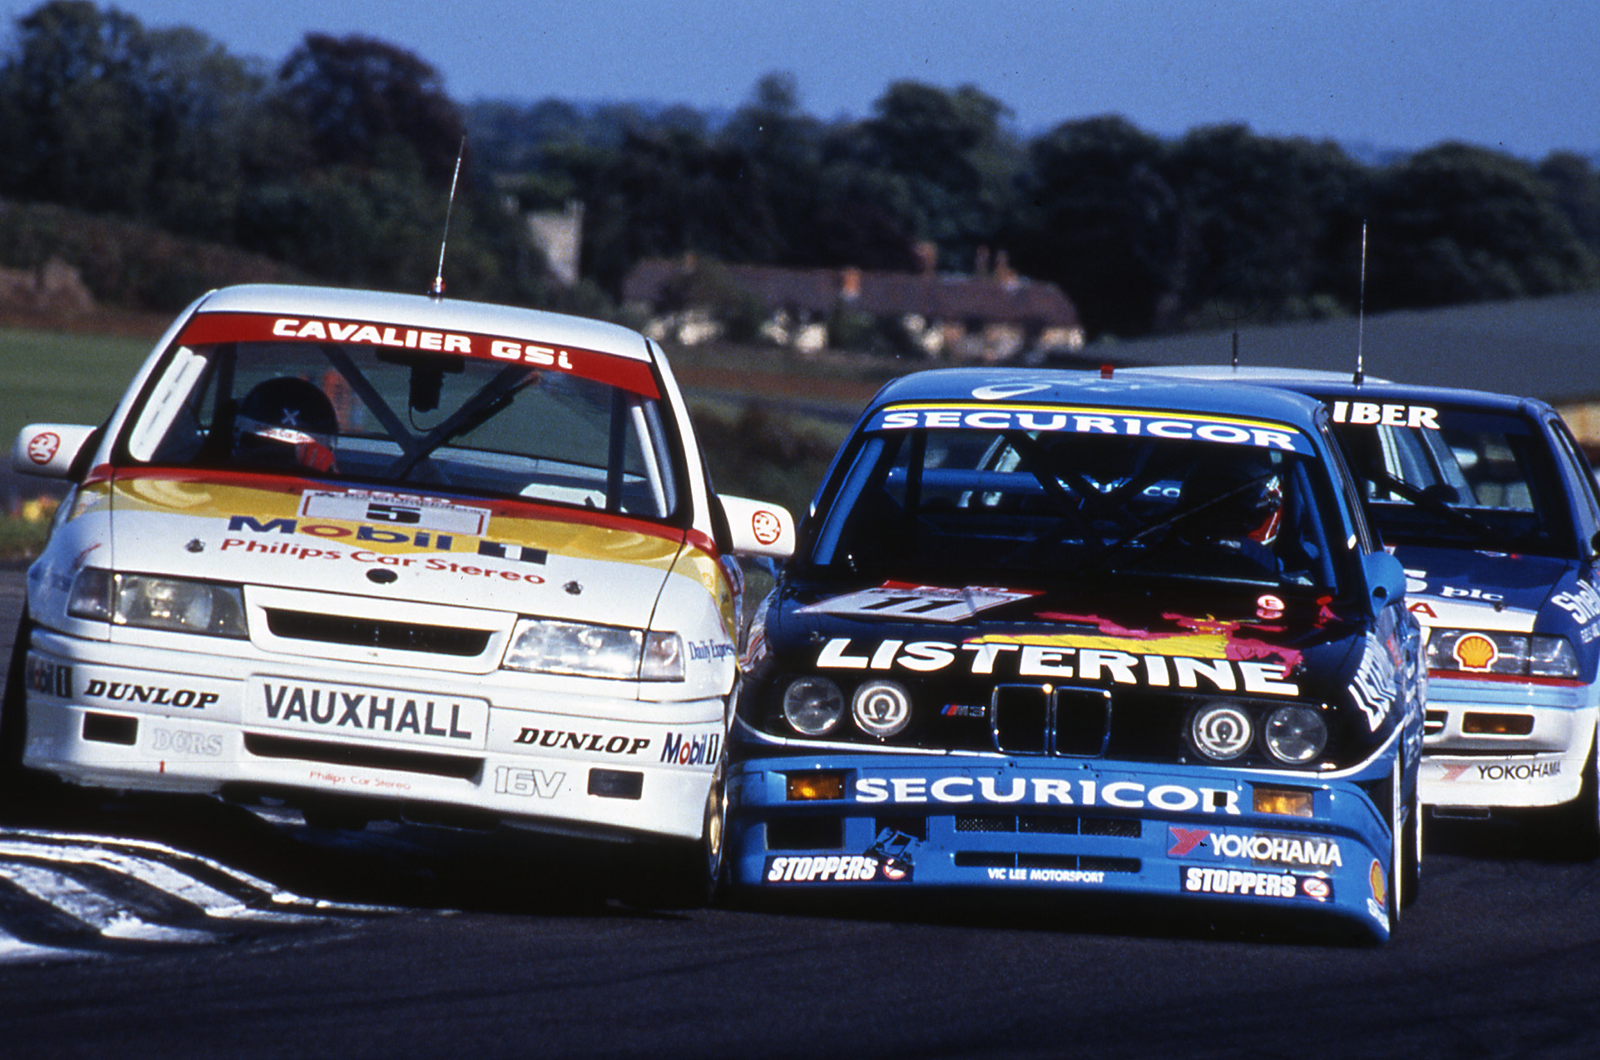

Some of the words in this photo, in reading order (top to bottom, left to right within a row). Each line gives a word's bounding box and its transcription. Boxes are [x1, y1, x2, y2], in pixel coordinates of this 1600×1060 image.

[272, 318, 472, 354] CAVALIER
[881, 410, 1297, 452] SECURICOR
[1332, 400, 1441, 430] IBER
[365, 502, 422, 524] 5
[227, 514, 454, 551] Mobil
[219, 537, 342, 561] Philips
[349, 550, 418, 568] Car
[425, 557, 547, 586] Stereo
[1440, 585, 1504, 600] plc
[688, 640, 711, 664] Daily
[815, 637, 1300, 696] LISTERINE
[84, 678, 220, 710] DUNLOP
[1347, 629, 1396, 733] LISTE
[263, 683, 472, 740] VAUXHALL
[513, 726, 651, 755] DUNLOP
[659, 731, 706, 766] Mobil
[350, 775, 371, 786] Car
[374, 778, 411, 791] Stereo
[494, 765, 567, 799] 16V
[854, 776, 1242, 815] SECURICOR
[1209, 832, 1343, 867] YOKOHAMA
[767, 855, 879, 882] STOPPERS
[987, 868, 1007, 880] VIC
[1009, 868, 1027, 880] LEE
[1029, 869, 1105, 884] MOTORSPORT
[1185, 867, 1297, 898] STOPPERS
